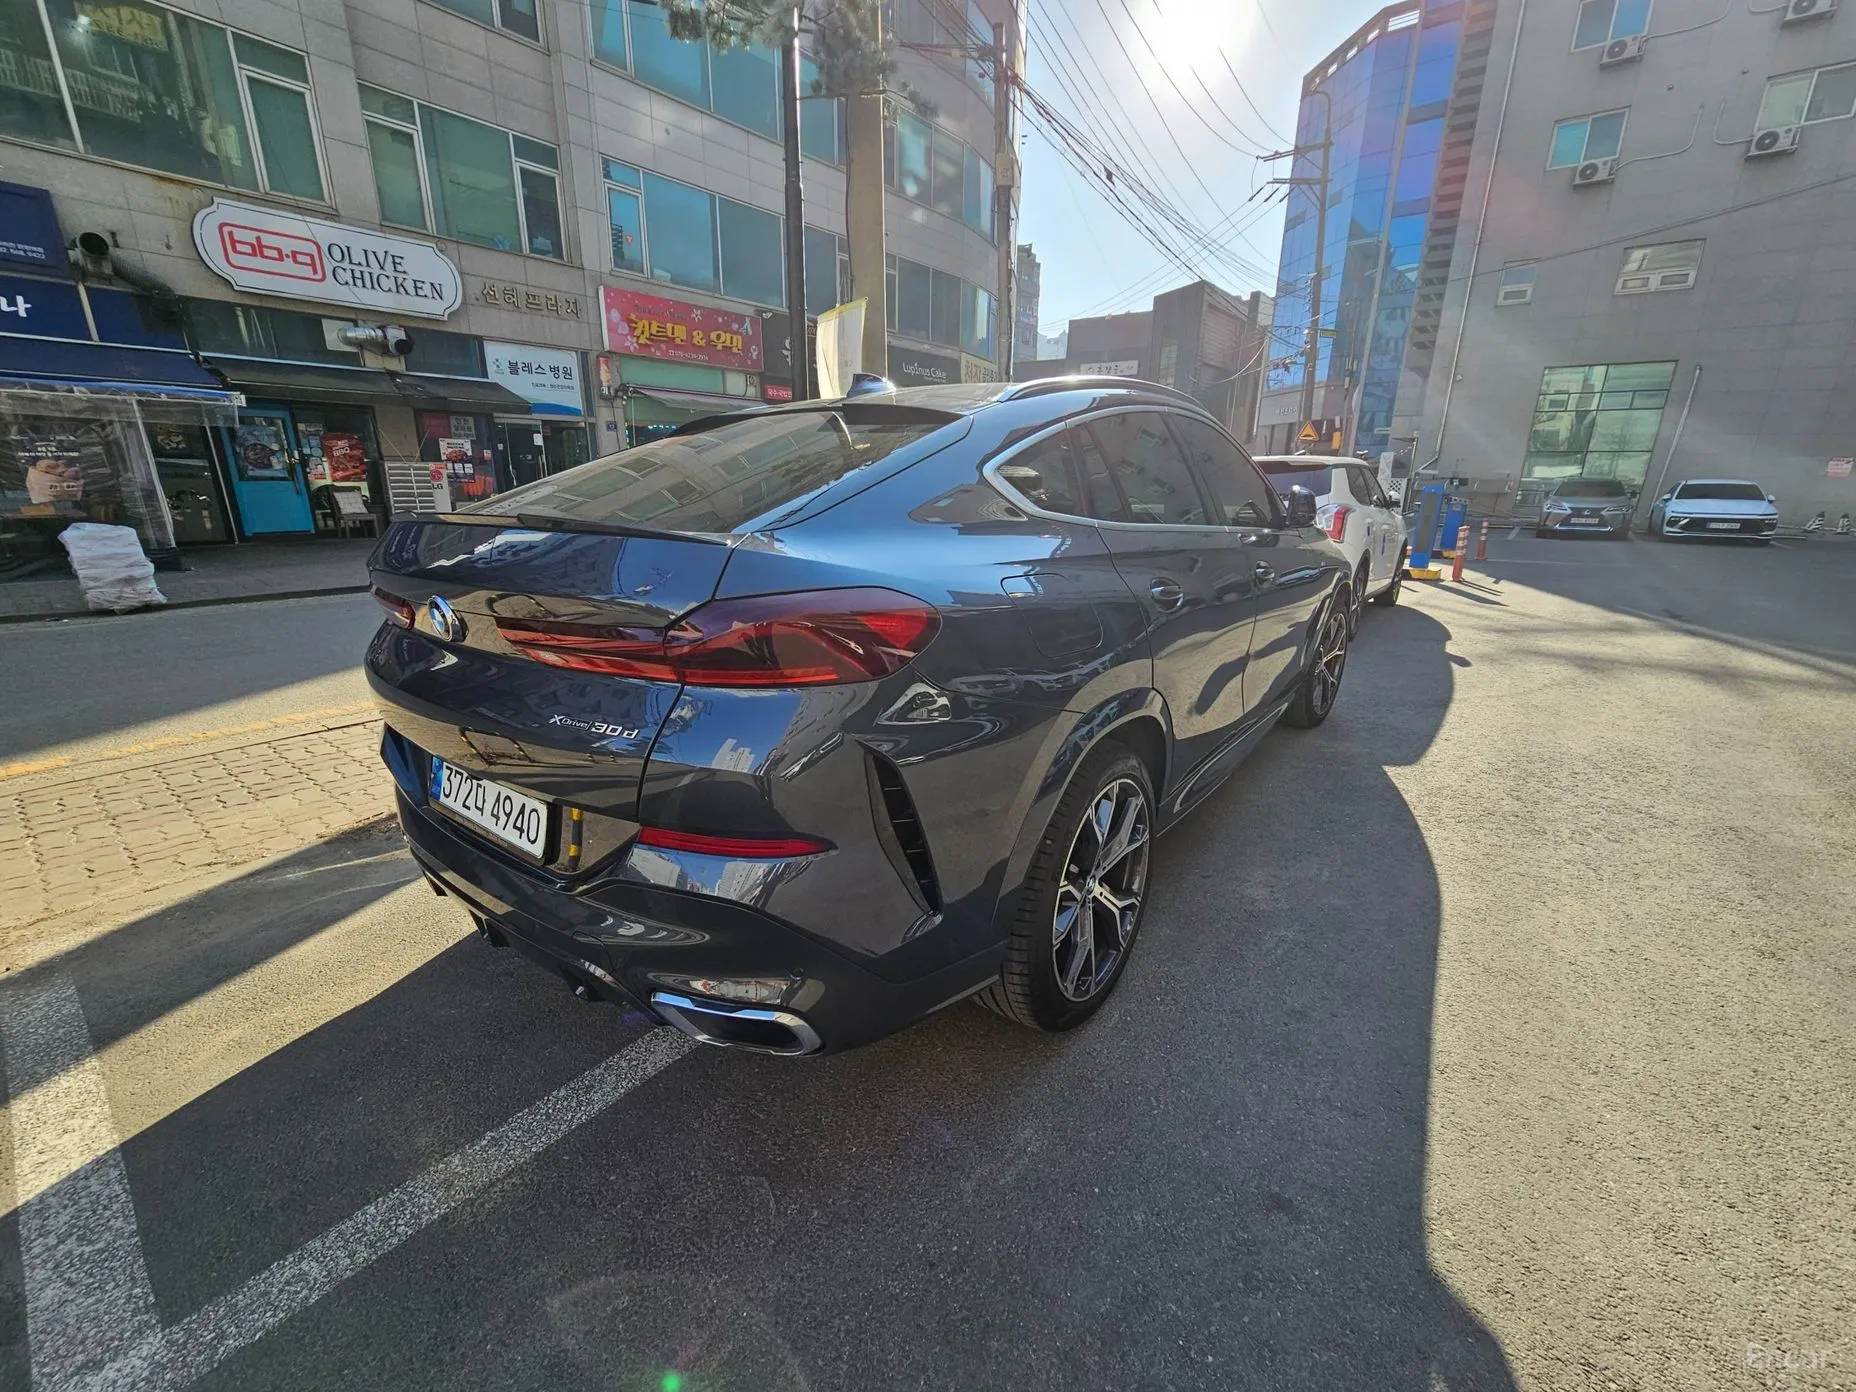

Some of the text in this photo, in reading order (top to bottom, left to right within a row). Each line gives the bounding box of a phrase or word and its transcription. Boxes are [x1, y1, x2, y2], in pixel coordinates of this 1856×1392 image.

[327, 242, 409, 275] OLIVE
[331, 265, 445, 301] CHICKEN
[692, 330, 706, 347] &
[507, 360, 547, 376] 블레스
[548, 364, 573, 380] 병원
[930, 367, 947, 379] Cake
[443, 766, 540, 845] 372다 4940
